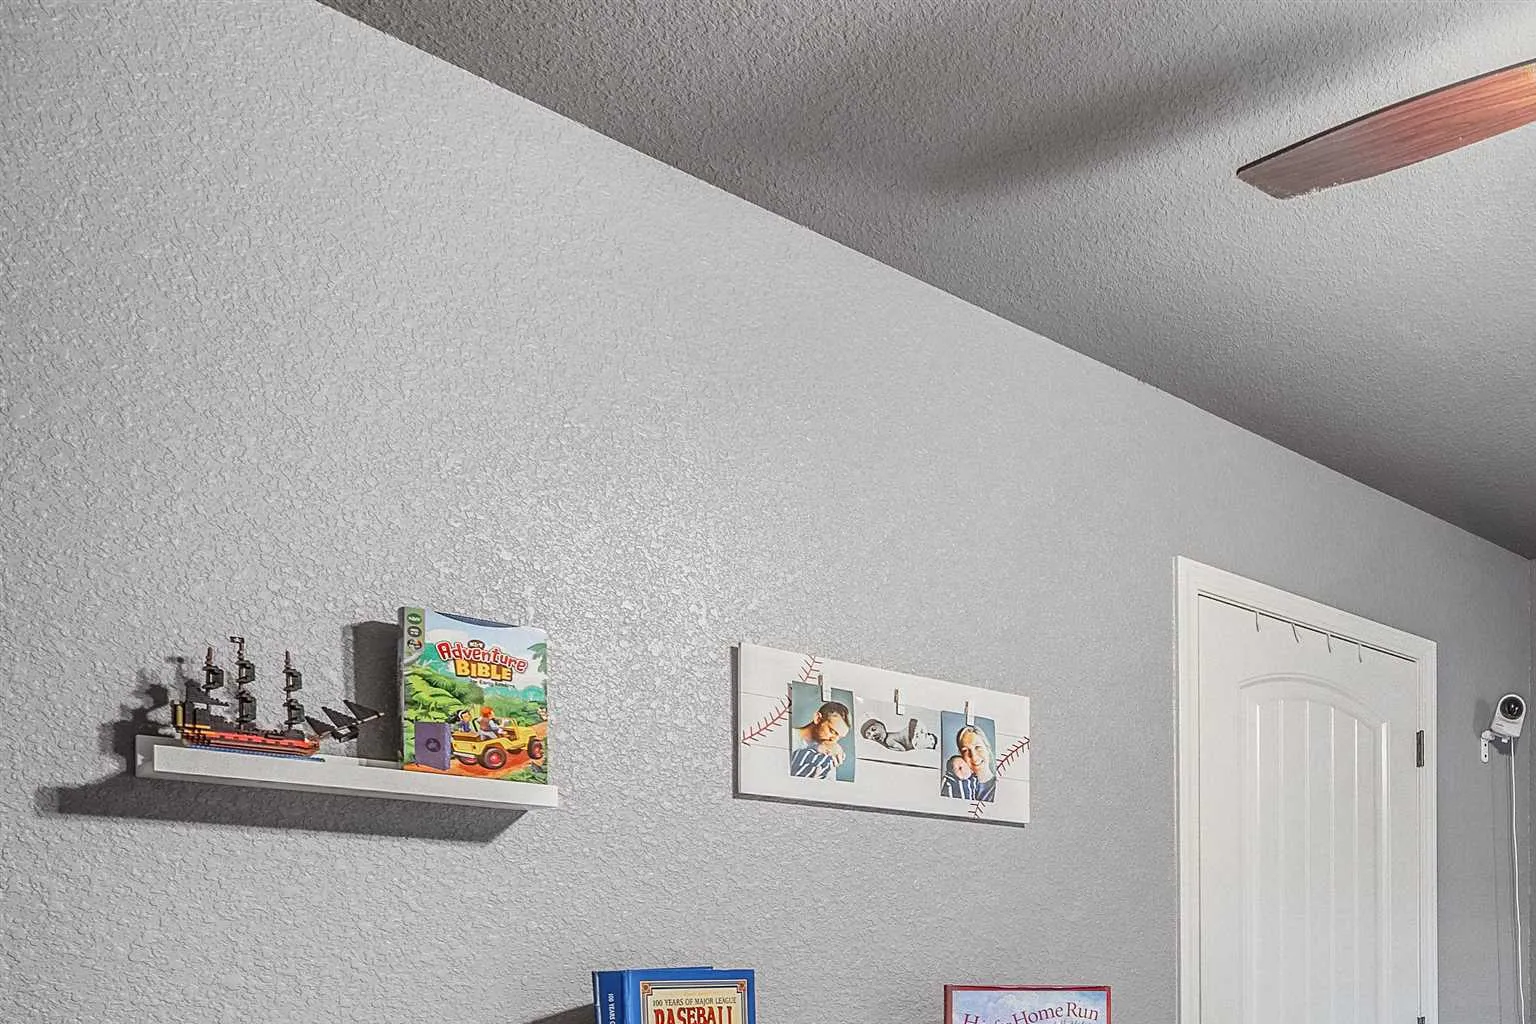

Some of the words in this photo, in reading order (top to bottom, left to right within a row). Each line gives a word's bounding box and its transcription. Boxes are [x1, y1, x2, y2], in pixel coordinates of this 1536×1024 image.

[436, 641, 528, 673] Adventure
[455, 659, 512, 681] BIBLE
[694, 998, 713, 1006] MAJOR
[1066, 1002, 1098, 1020] Run
[608, 1003, 616, 1020] YEARS
